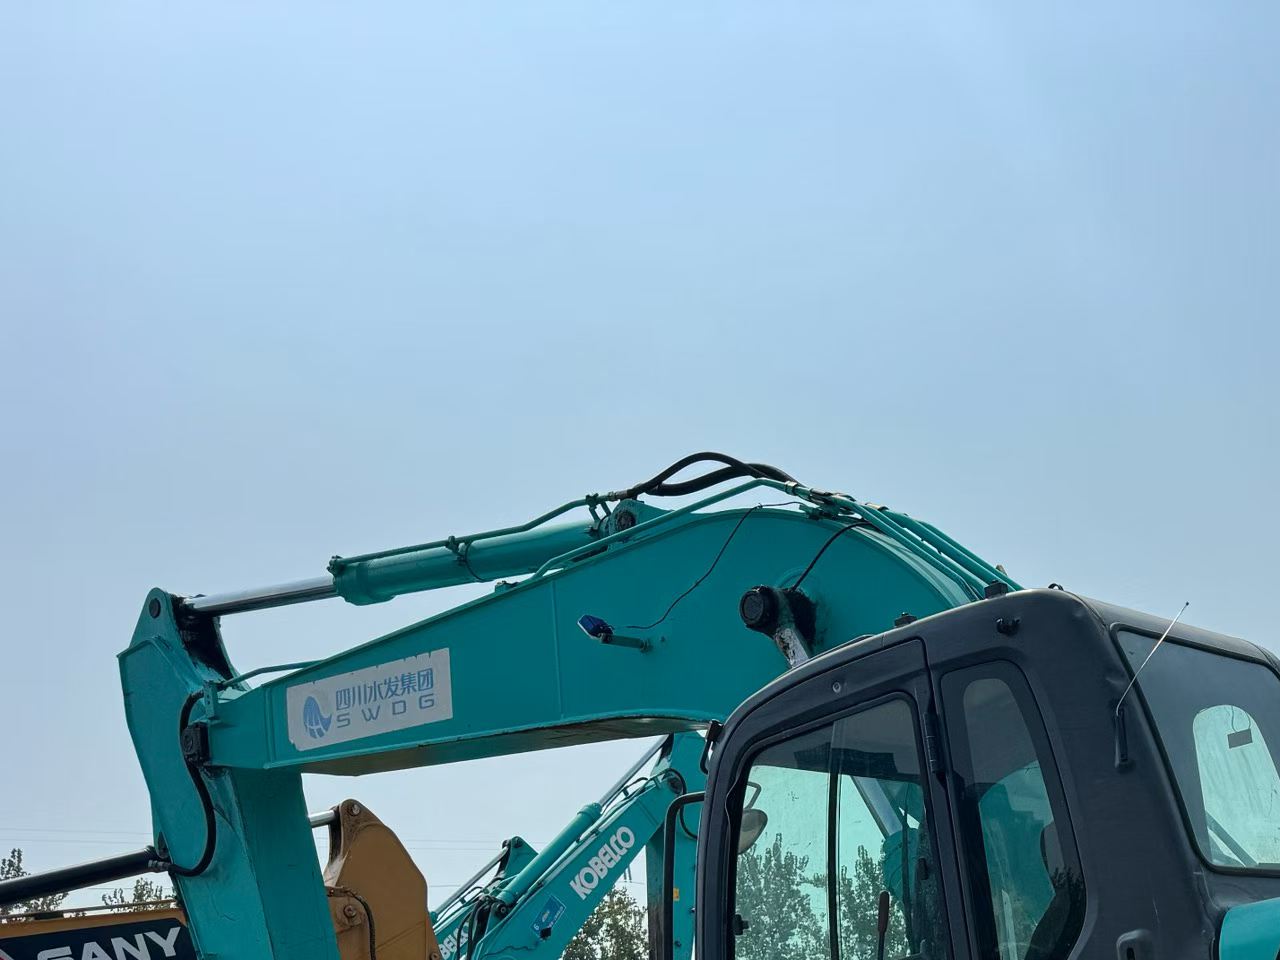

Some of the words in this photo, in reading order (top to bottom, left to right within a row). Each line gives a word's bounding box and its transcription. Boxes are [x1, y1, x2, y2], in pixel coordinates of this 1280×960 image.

[336, 667, 434, 711] 四川水发集团
[569, 826, 635, 900] KOBELCO
